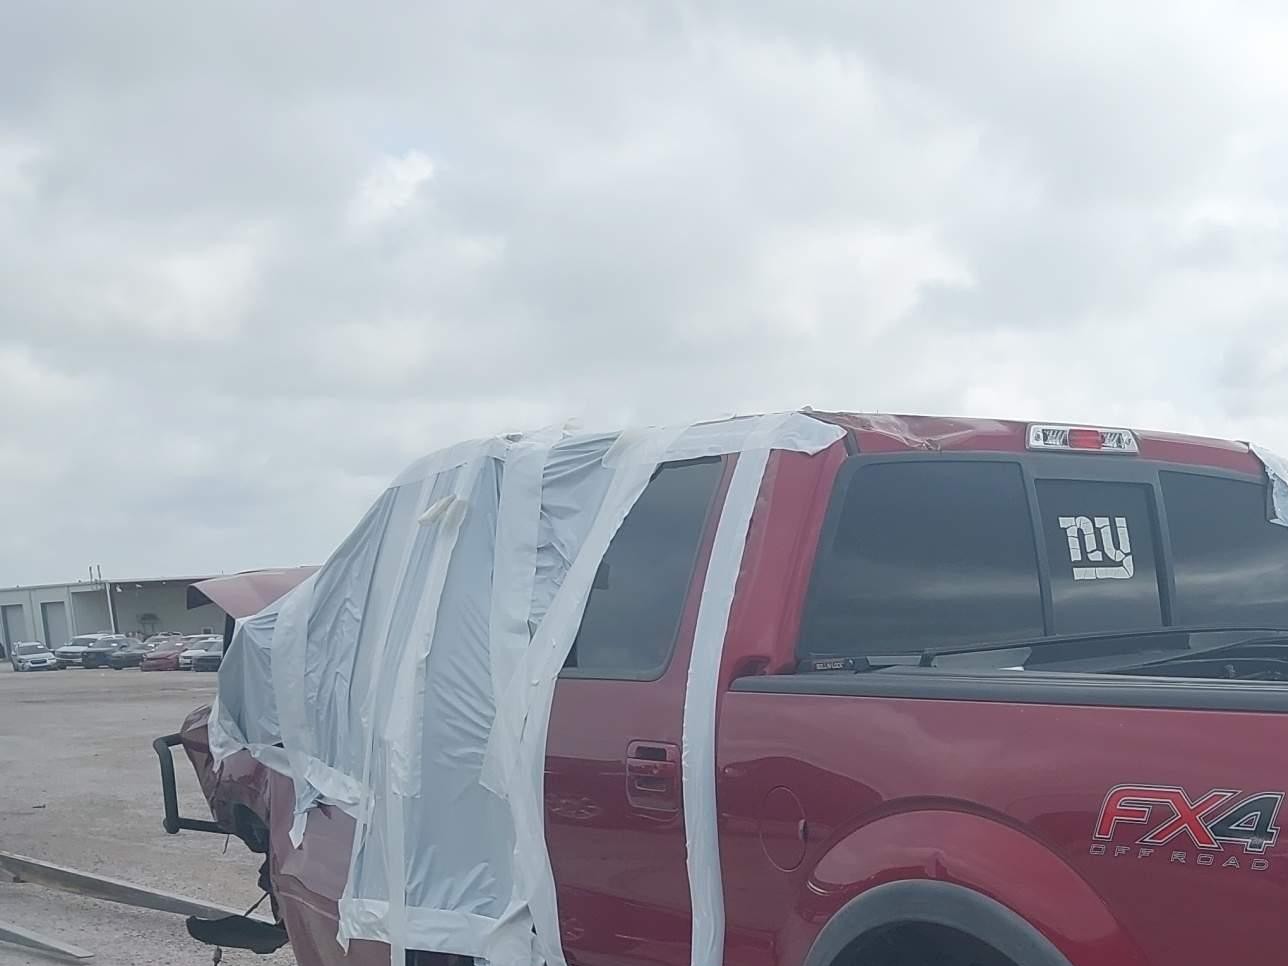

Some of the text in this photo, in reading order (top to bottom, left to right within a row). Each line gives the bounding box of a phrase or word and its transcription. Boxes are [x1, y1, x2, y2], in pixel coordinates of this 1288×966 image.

[1093, 784, 1285, 854] FX4
[1089, 844, 1269, 870] OFF ROAD
